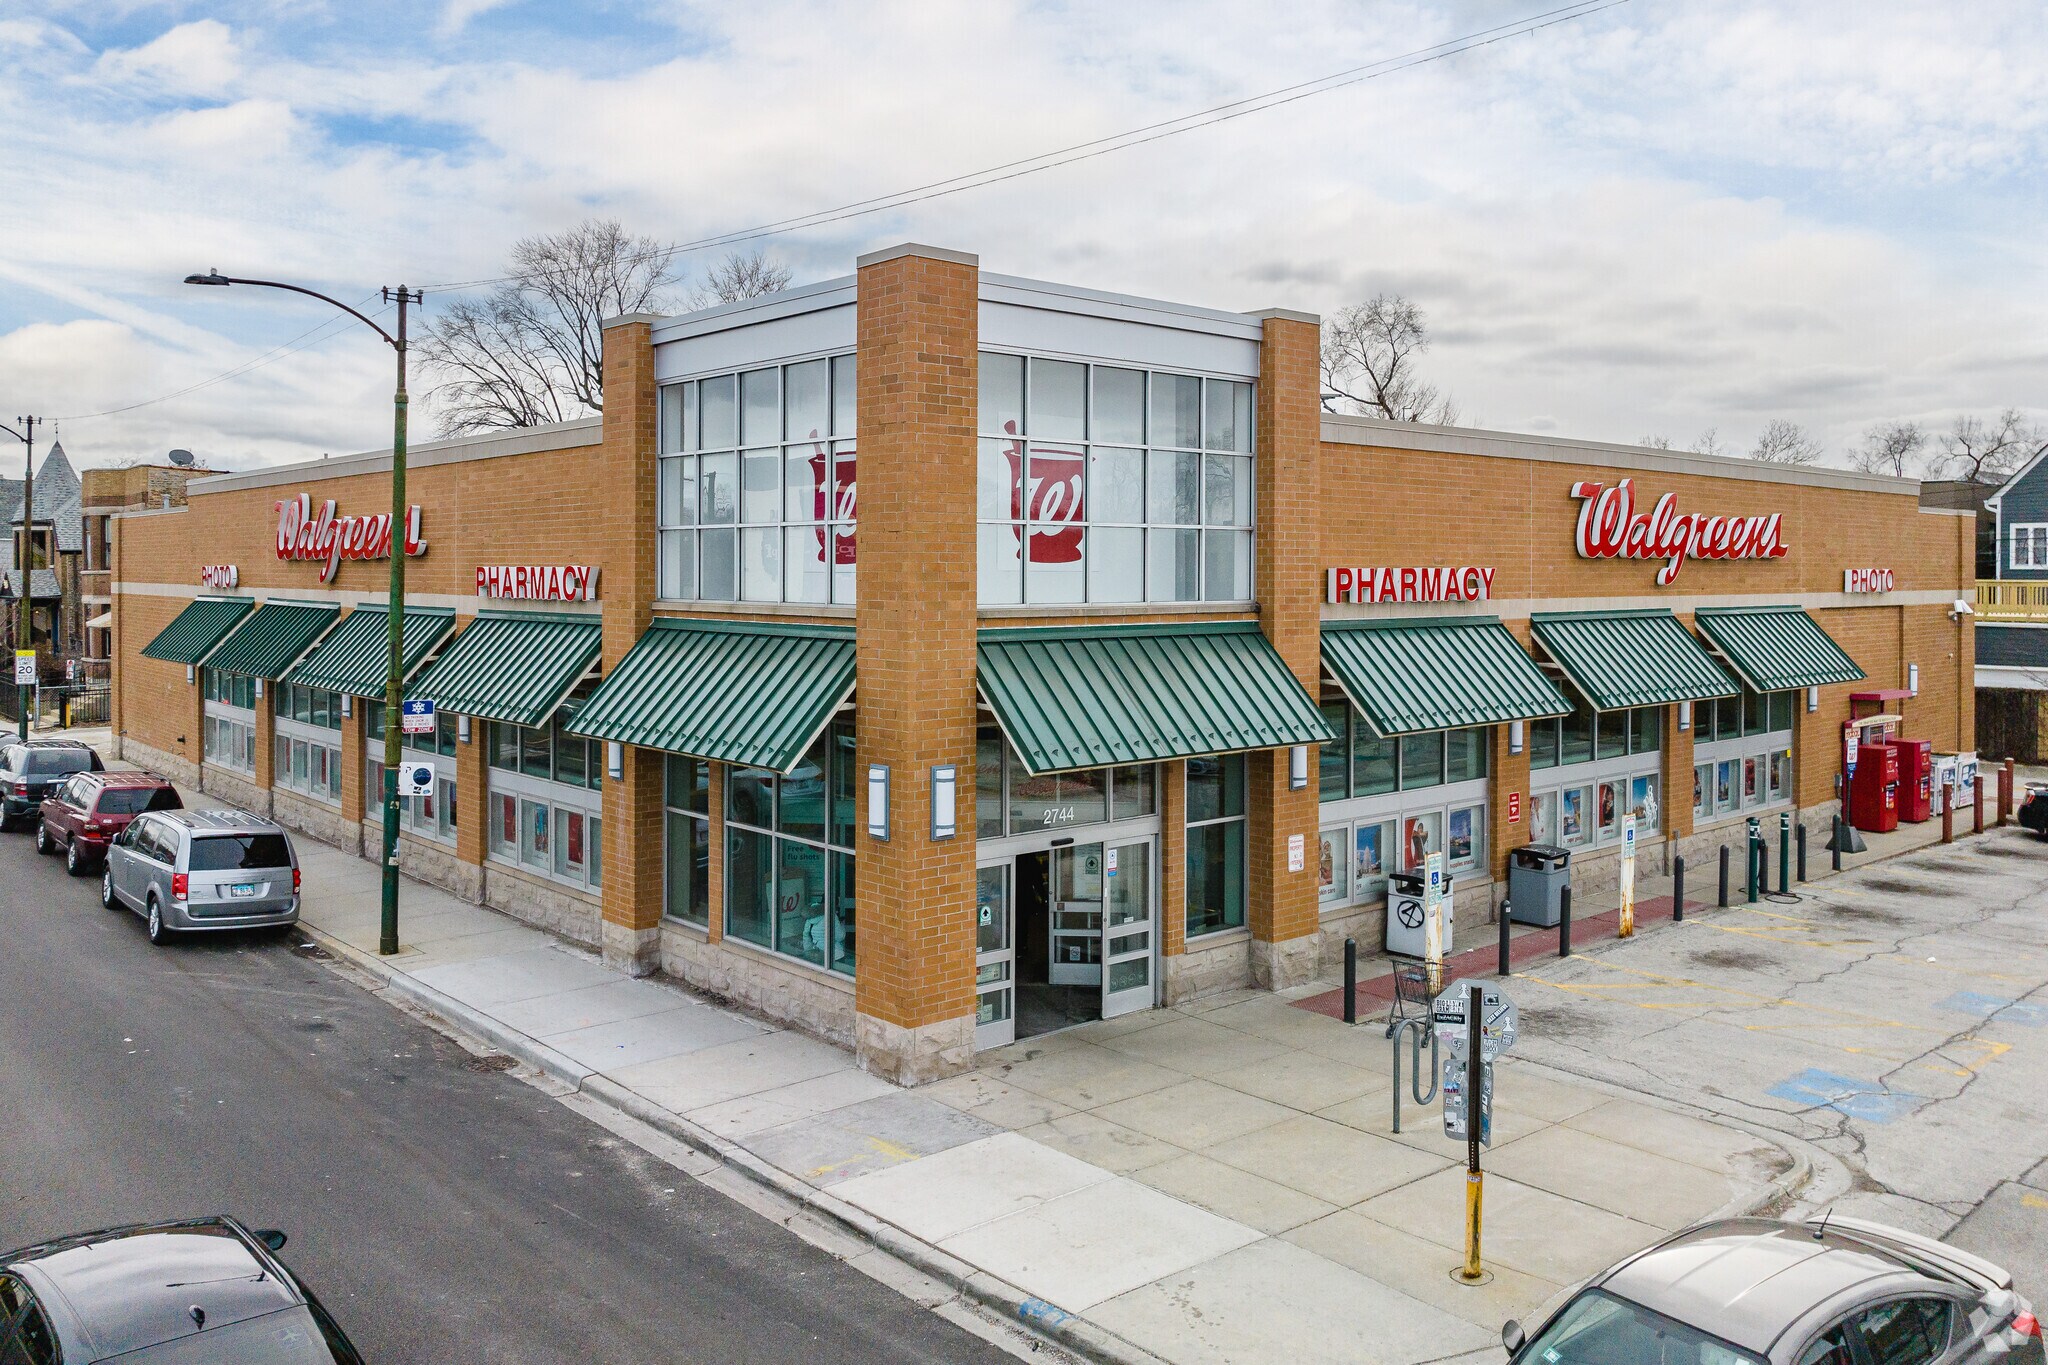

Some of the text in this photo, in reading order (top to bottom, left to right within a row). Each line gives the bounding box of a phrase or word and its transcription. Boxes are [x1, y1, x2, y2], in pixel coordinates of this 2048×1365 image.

[1571, 479, 1789, 586] Walgreens
[202, 565, 238, 588] PHOTO
[476, 565, 600, 602] PHARMACY
[1328, 566, 1497, 604] PHARMACY
[1845, 568, 1894, 593] PHOTO
[18, 665, 33, 674] 20
[1043, 806, 1075, 825] 2744
[787, 852, 820, 860] flu shots
